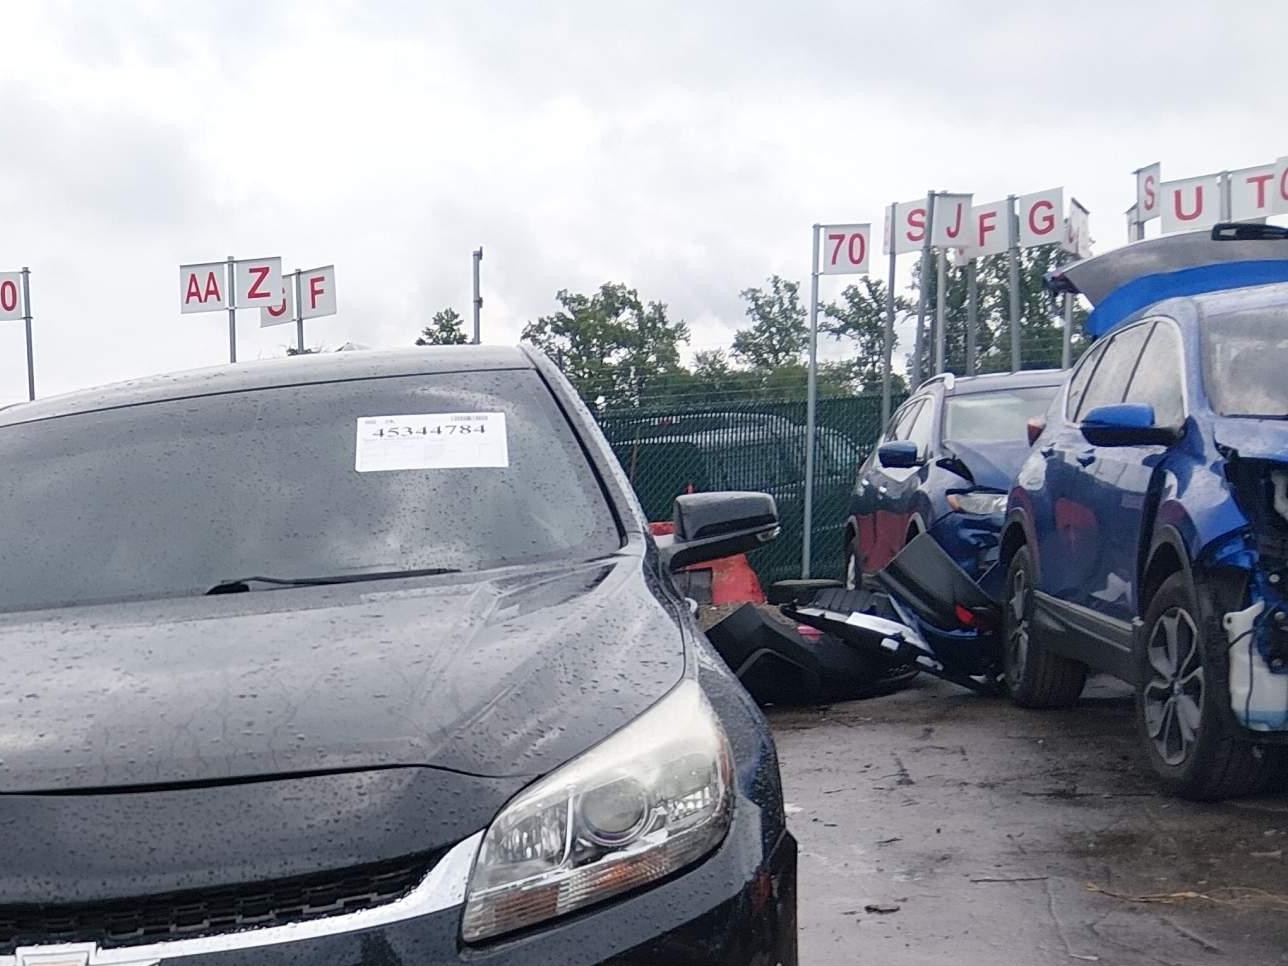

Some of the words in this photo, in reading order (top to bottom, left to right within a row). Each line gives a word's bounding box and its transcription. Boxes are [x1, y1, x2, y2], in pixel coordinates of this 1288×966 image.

[1143, 175, 1155, 211] S
[1174, 185, 1203, 221] U
[1246, 174, 1274, 208] T
[906, 208, 927, 242] S
[946, 202, 962, 239] J
[979, 211, 997, 247] F
[1028, 200, 1055, 236] G
[828, 233, 865, 266] 70
[184, 271, 222, 305] AA
[247, 266, 271, 299] Z
[309, 276, 325, 309] F
[372, 424, 487, 439] 45344784
